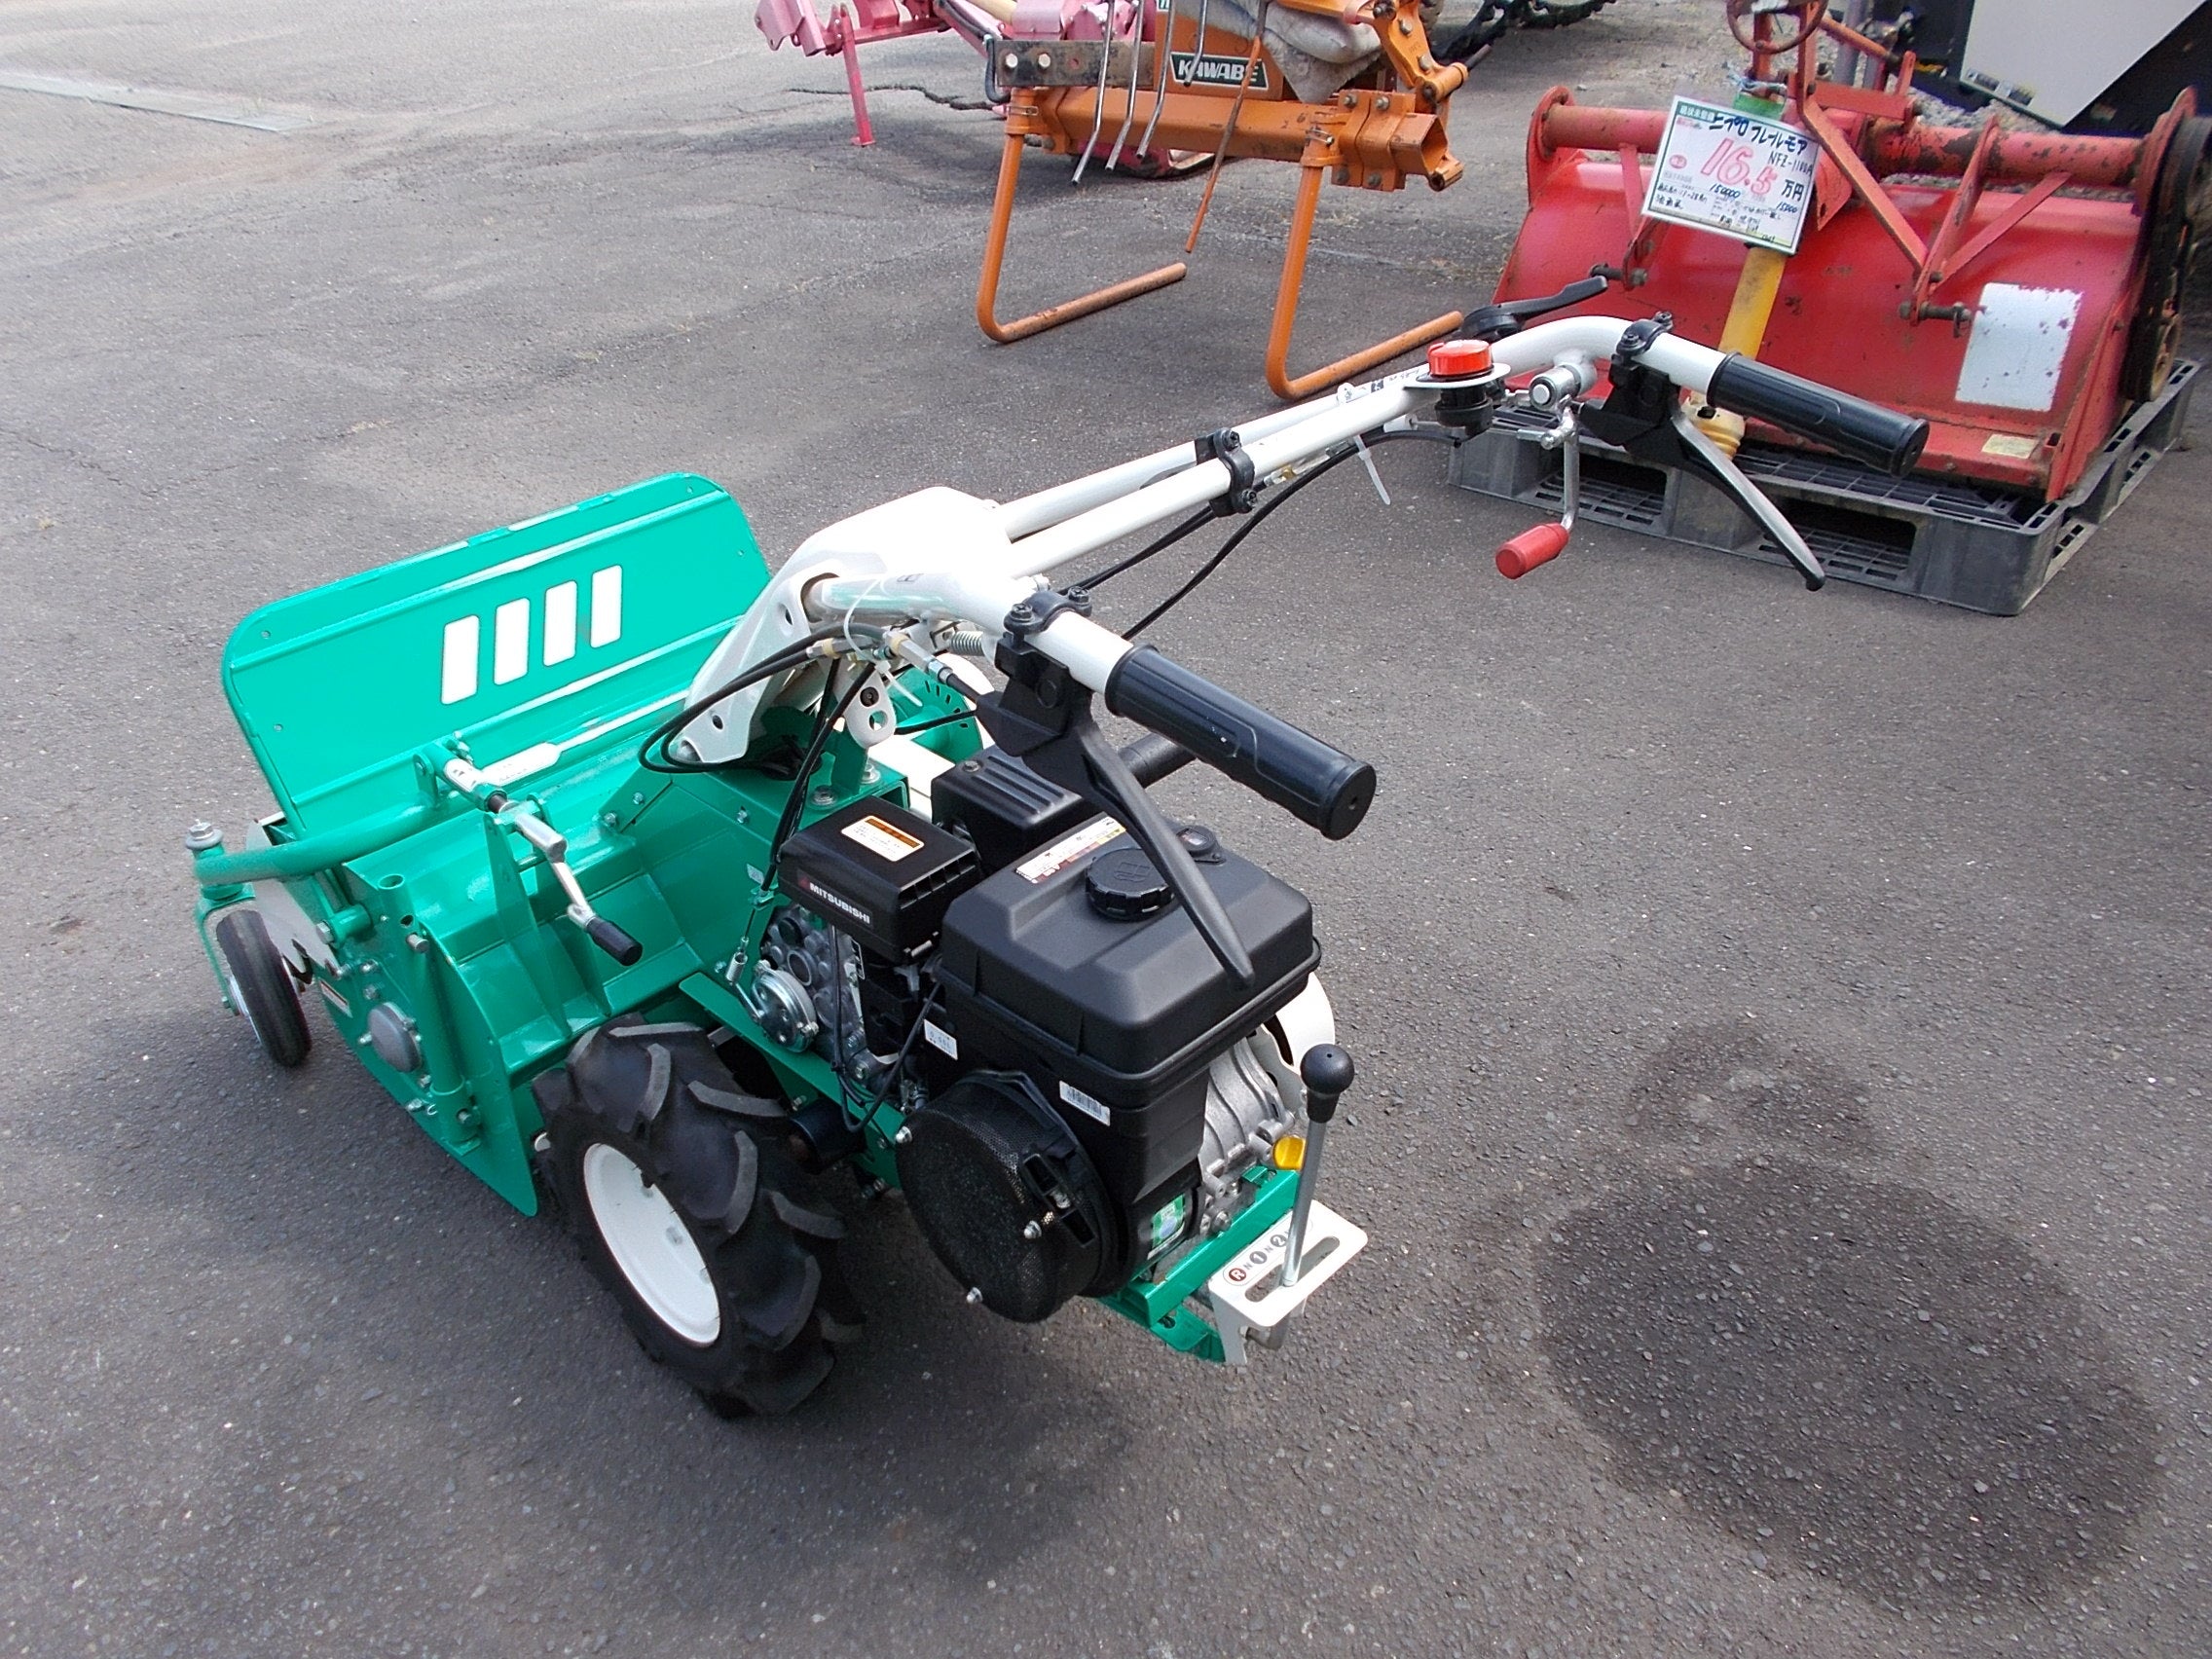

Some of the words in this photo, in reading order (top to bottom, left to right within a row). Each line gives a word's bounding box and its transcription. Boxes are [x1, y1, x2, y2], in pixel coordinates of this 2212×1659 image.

[1701, 137, 1779, 195] 16.5
[1781, 179, 1805, 202] 万円
[809, 881, 871, 925] MITSUBISHI
[1230, 1269, 1246, 1281] R
